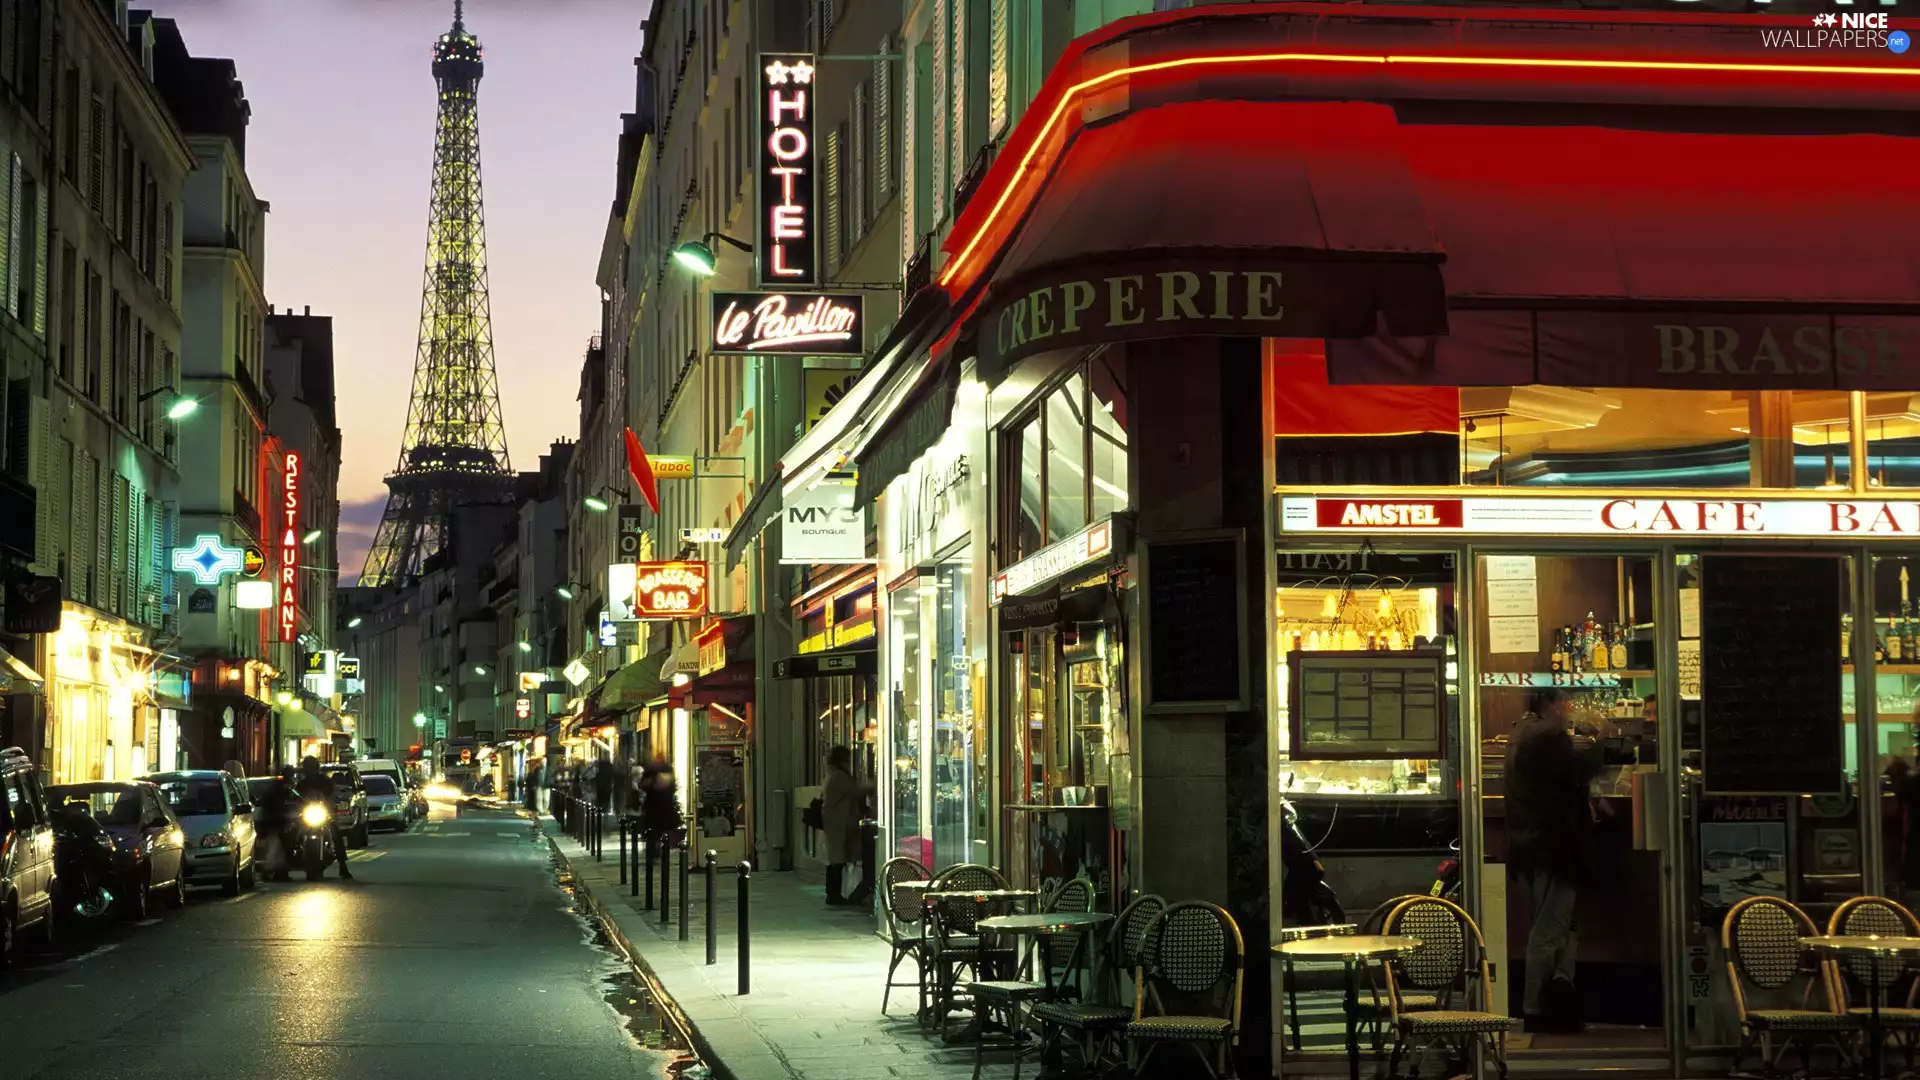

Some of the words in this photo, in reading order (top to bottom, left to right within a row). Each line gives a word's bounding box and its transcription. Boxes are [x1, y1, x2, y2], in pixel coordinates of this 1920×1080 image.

[770, 90, 807, 277] HOTEL
[717, 301, 747, 344] Le
[751, 295, 856, 339] Pavillon
[998, 271, 1284, 354] CREPERIE
[653, 461, 690, 471] Tabac
[1340, 503, 1440, 525] AMSTEL
[1600, 499, 1765, 532] CAFE
[282, 454, 297, 640] RESTAURANT
[637, 569, 705, 595] BRASSERIE
[653, 591, 689, 609] BAR
[340, 665, 357, 673] CCF
[1481, 672, 1533, 687] BAR
